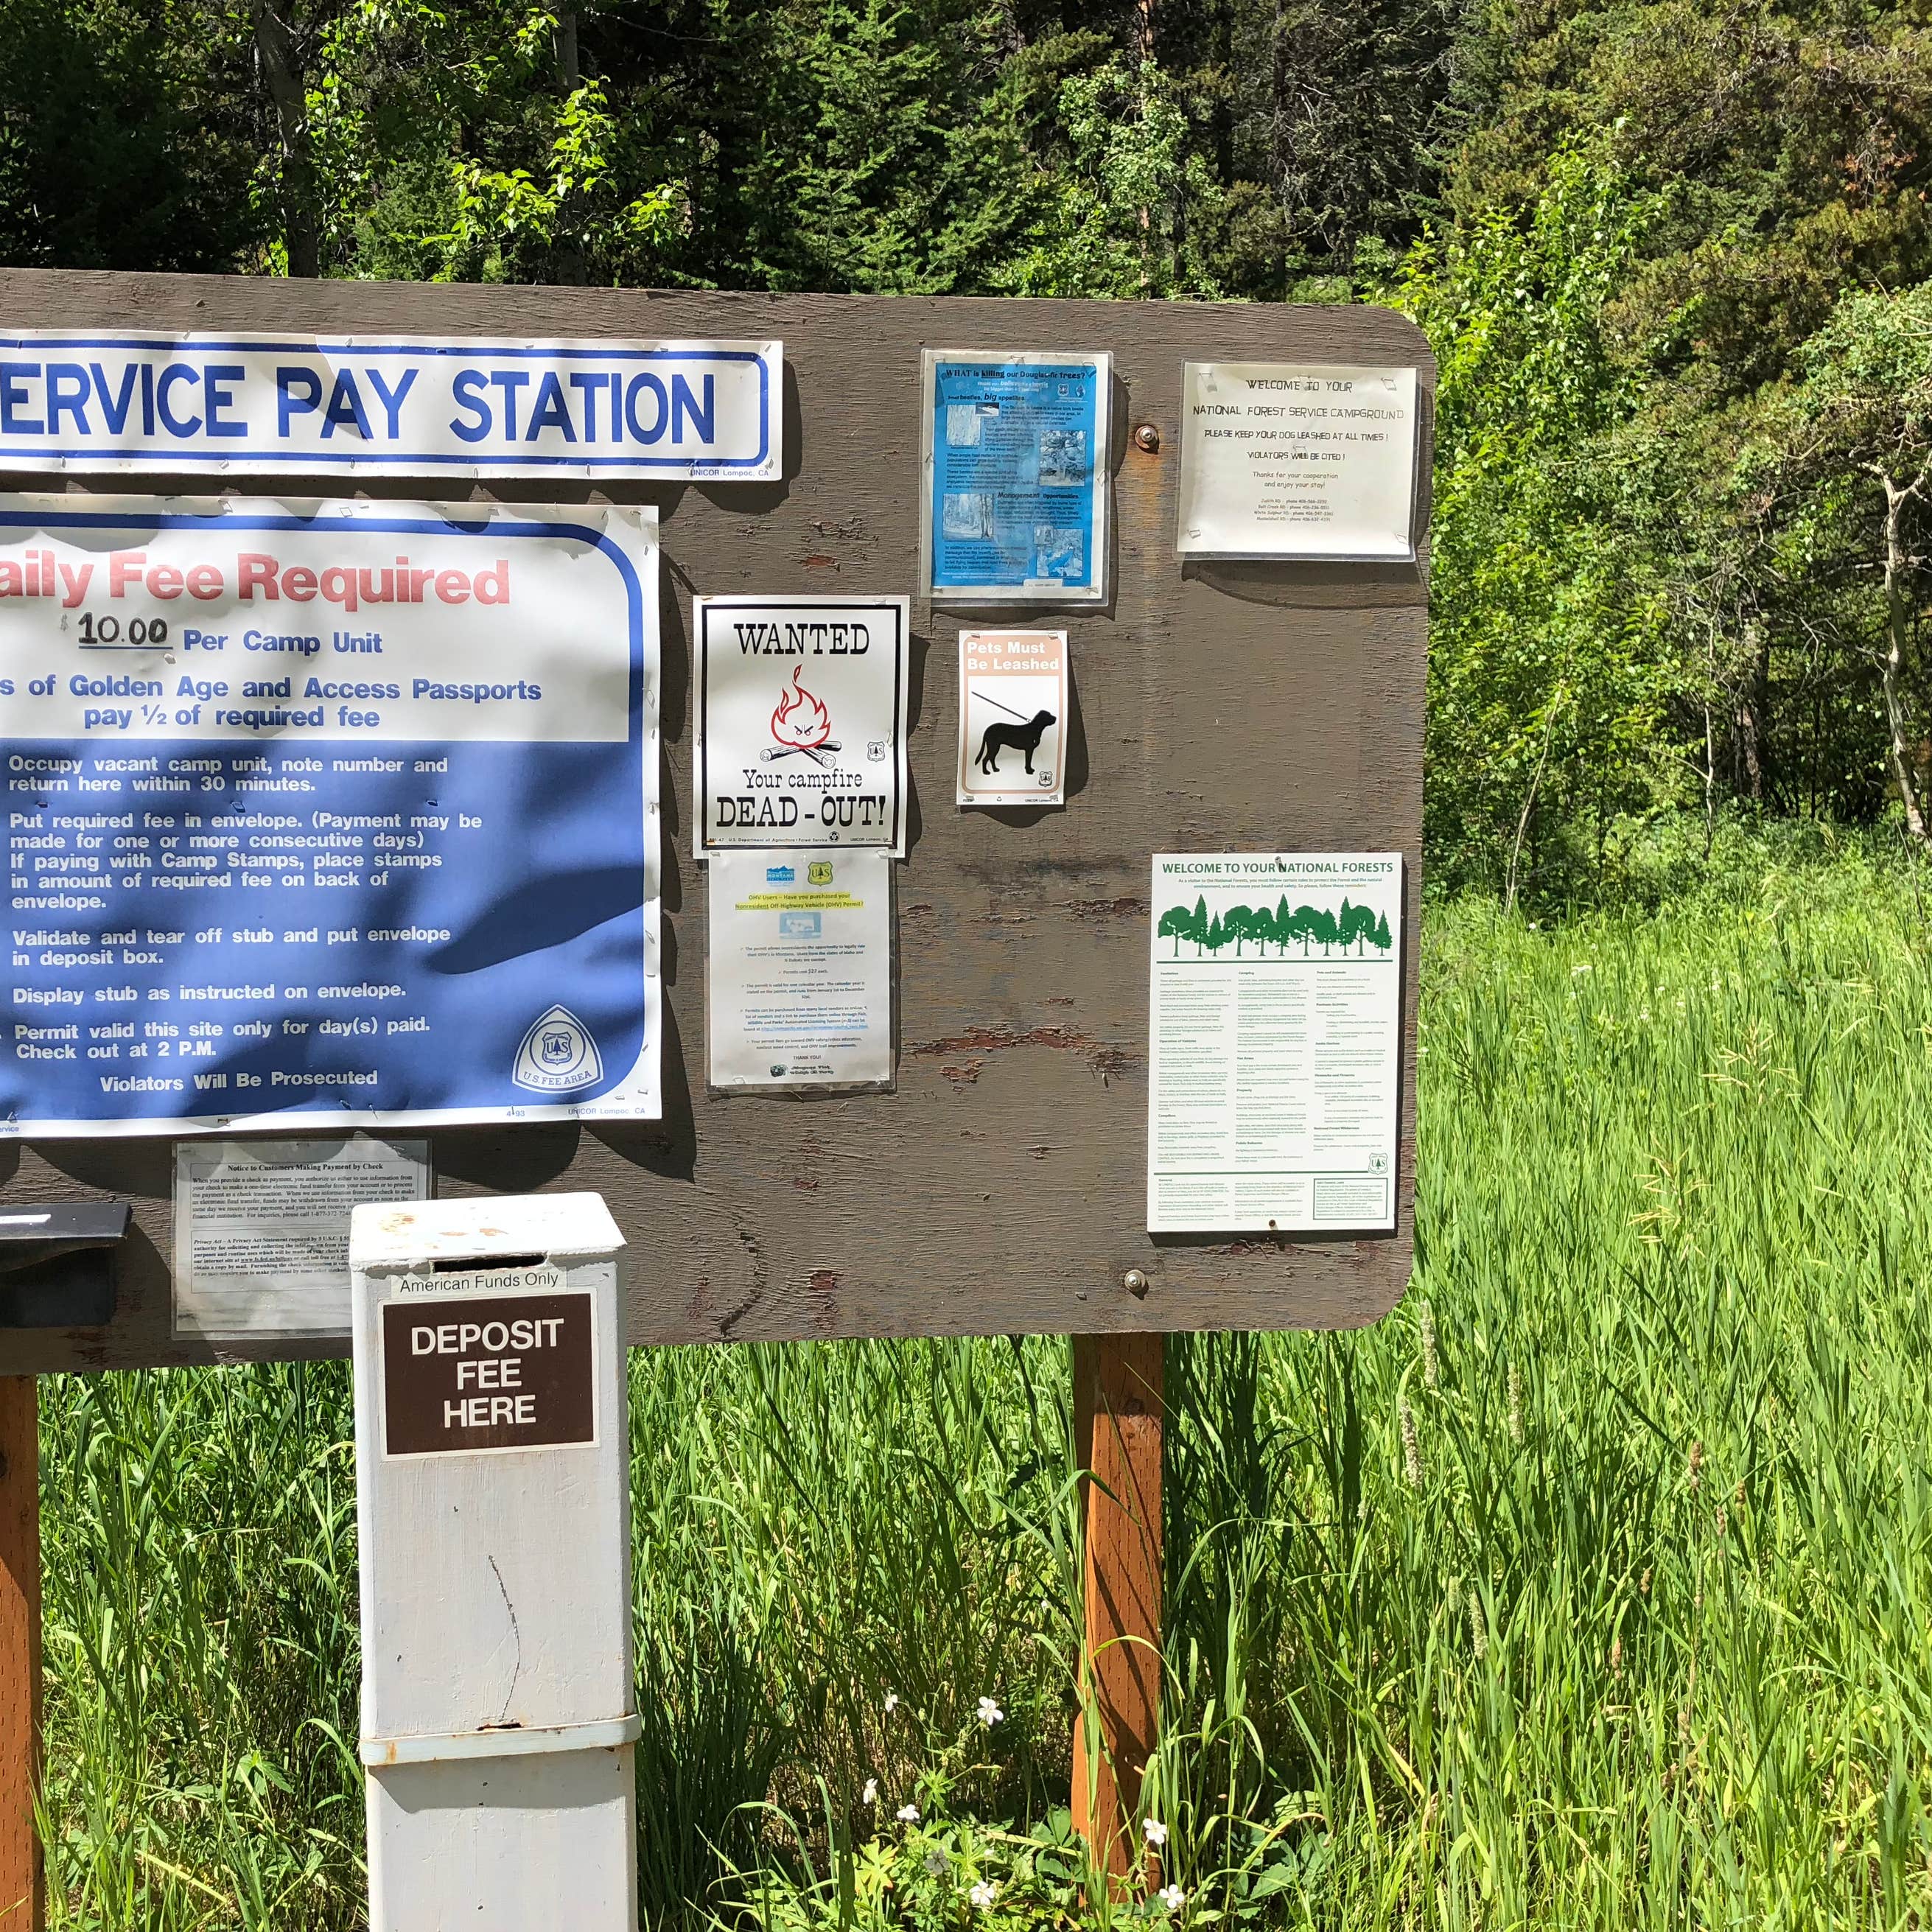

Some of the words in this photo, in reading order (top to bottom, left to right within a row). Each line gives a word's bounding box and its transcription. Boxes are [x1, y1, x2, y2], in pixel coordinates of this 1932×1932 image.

[981, 370, 1004, 378] killing
[1246, 380, 1300, 391] WELCOME
[1306, 382, 1320, 391] TO
[1326, 382, 1352, 393] YOUR
[0, 363, 248, 438] ERVICE
[276, 367, 419, 439] PAY
[449, 370, 714, 444] STATION
[1193, 405, 1241, 415] NATIONAL
[1247, 407, 1284, 416] FOREST
[1289, 407, 1327, 418] SERVICE
[1331, 409, 1404, 420] CAMPGROUND
[1235, 430, 1253, 438] KEEP
[1256, 431, 1277, 439] YOUR
[1298, 431, 1330, 440] LEASHED
[1345, 433, 1359, 441] ALL
[110, 553, 224, 600] Fee
[237, 553, 509, 612] Required
[78, 612, 168, 645] 10.00
[184, 630, 228, 650] Per
[243, 630, 321, 657] Camp
[334, 632, 382, 653] Unit
[734, 623, 869, 654] WANTED
[967, 642, 1002, 654] Pets
[1008, 642, 1045, 654] Must
[967, 658, 987, 670] Be
[993, 658, 1059, 670] Leashed
[29, 674, 56, 696] of
[69, 675, 163, 696] Golden
[177, 676, 228, 701] Age
[242, 677, 291, 698] and
[304, 678, 400, 699] Access
[413, 679, 542, 704] Passports
[85, 710, 132, 729] pay
[175, 707, 200, 725] of
[216, 706, 323, 729] required
[337, 706, 379, 727] fee
[9, 755, 83, 774] Occupy
[94, 757, 158, 771] vacant
[169, 760, 222, 774] camp
[232, 757, 272, 774] unit,
[282, 757, 323, 771] note
[333, 757, 404, 771] number
[414, 757, 447, 772] and
[10, 777, 69, 791] return
[79, 776, 122, 791] here
[133, 777, 190, 791] within
[201, 776, 225, 791] 30
[236, 777, 315, 791] minutes.
[743, 769, 782, 788] Your
[788, 769, 862, 793] campfire
[1163, 864, 1222, 873] WELCOME
[1225, 864, 1240, 873] TO
[1243, 864, 1275, 873] YOUR
[1278, 863, 1338, 872] NATIONAL
[1342, 863, 1393, 872] FORESTS
[13, 931, 91, 945] Validate
[101, 929, 136, 945] and
[147, 930, 185, 944] tear
[195, 928, 222, 943] off
[233, 928, 273, 942] stub
[284, 928, 318, 942] and
[328, 928, 358, 945] put
[368, 926, 450, 943] envelope
[13, 951, 29, 965] in
[40, 950, 113, 967] deposit
[124, 949, 164, 964] box.
[15, 1024, 79, 1039] Permit
[89, 1023, 134, 1038] valid
[144, 1022, 179, 1037] this
[189, 1022, 223, 1036] site
[233, 1021, 272, 1038] only
[282, 1020, 309, 1034] for
[319, 1017, 378, 1037] day(s)
[388, 1017, 430, 1035] paid.
[17, 1044, 77, 1059] Check
[88, 1043, 119, 1058] out
[130, 1043, 148, 1057] at
[158, 1042, 169, 1056] 2
[179, 1041, 216, 1056] P.M.
[100, 1076, 183, 1092] Violators
[194, 1074, 227, 1089] Will
[237, 1073, 262, 1087] Be
[271, 1070, 377, 1085] Prosecuted
[564, 1071, 592, 1084] AREA
[295, 1163, 321, 1172] Making
[323, 1163, 351, 1172] Payment
[400, 1278, 469, 1292] American
[475, 1275, 519, 1289] Funds
[525, 1273, 559, 1288] Only
[411, 1318, 564, 1355] DEPOSIT
[457, 1358, 522, 1390] FEE
[444, 1394, 536, 1428] HERE
